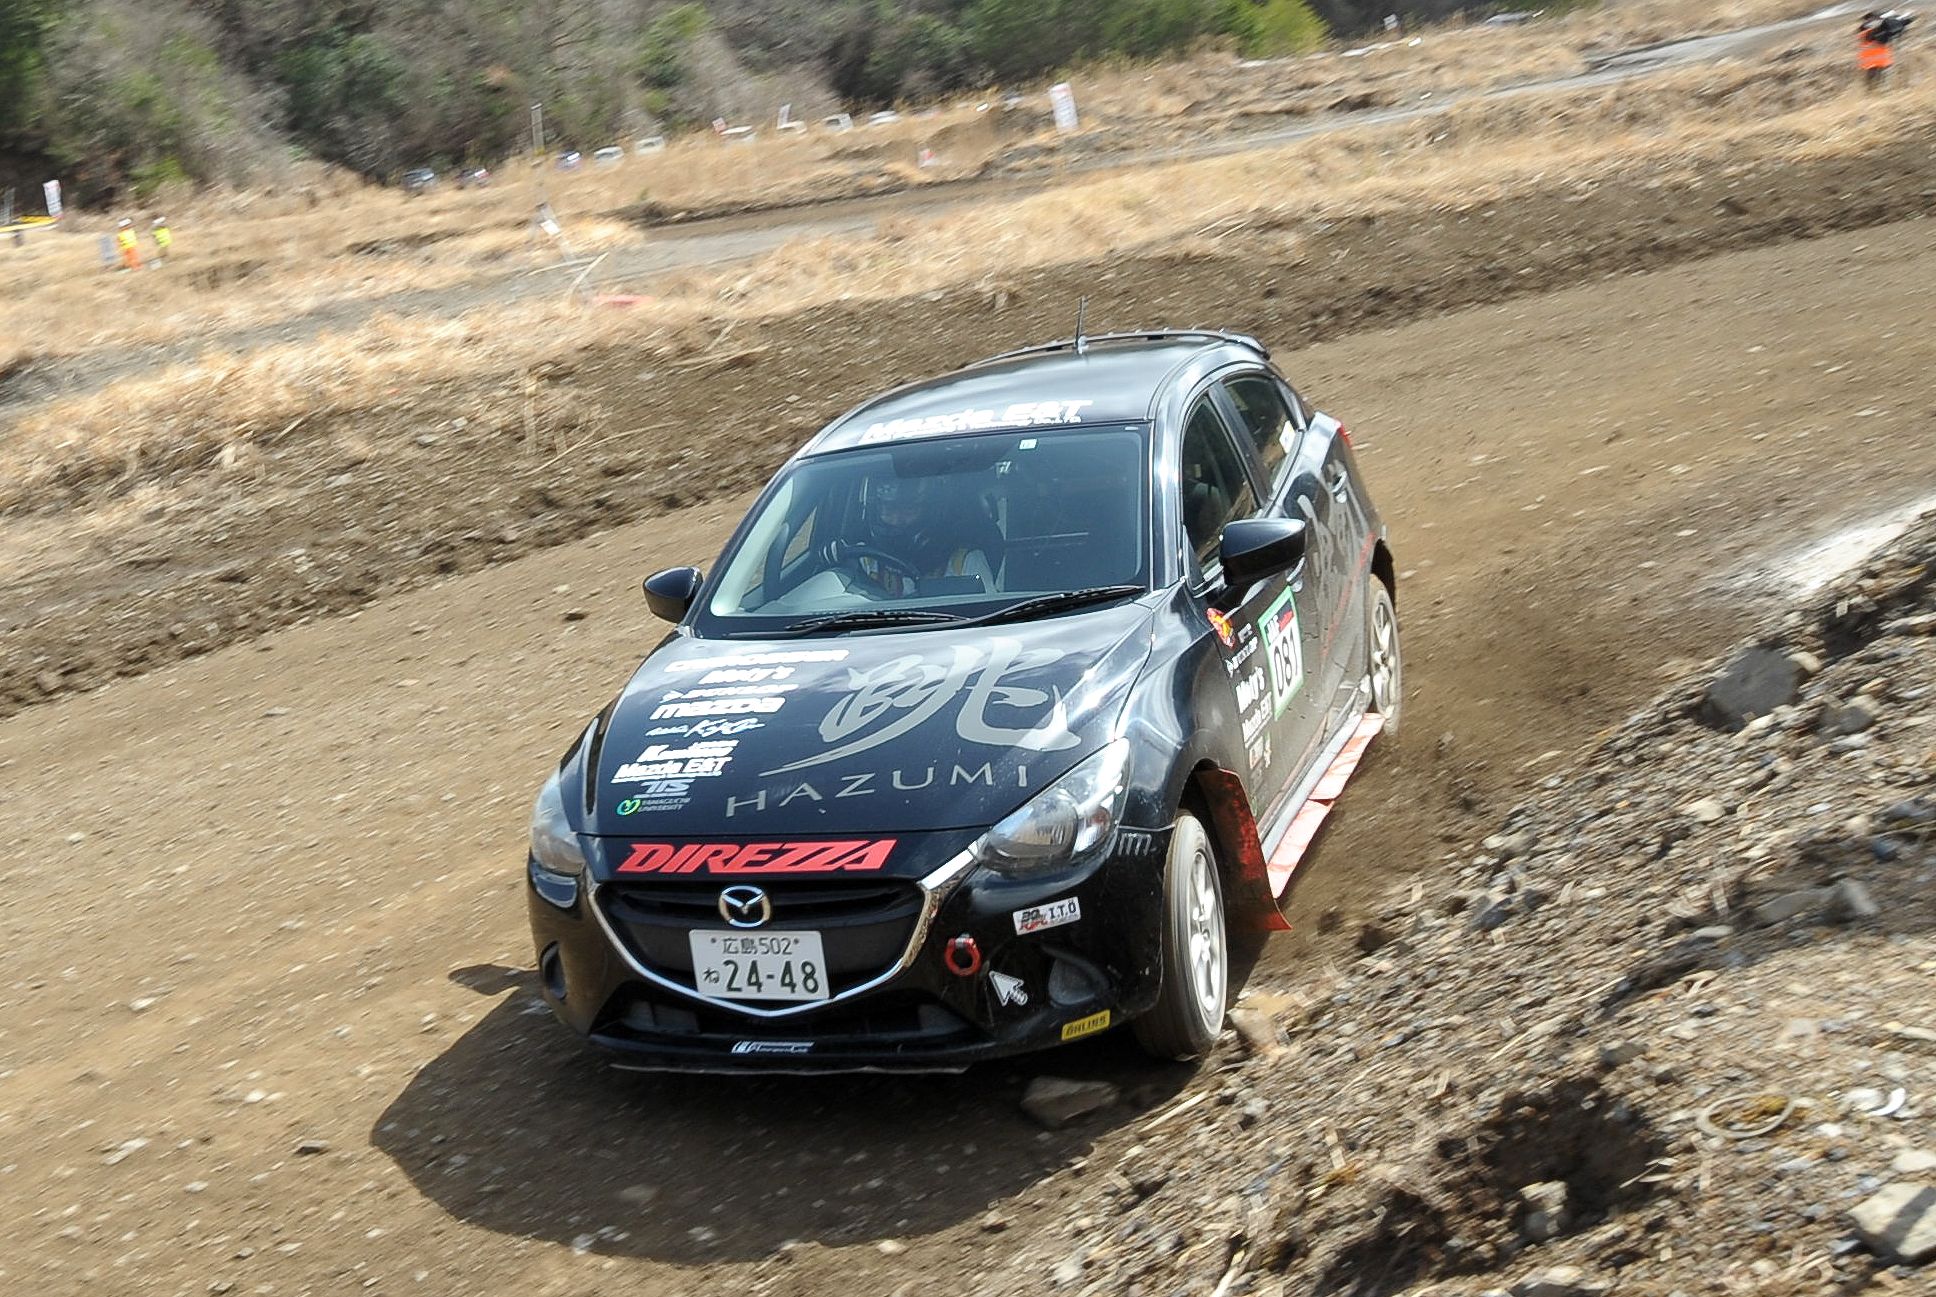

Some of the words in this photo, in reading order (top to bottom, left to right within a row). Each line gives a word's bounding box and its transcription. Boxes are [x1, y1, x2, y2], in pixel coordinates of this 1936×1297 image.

[725, 765, 1029, 818] HAZUMI
[616, 839, 898, 874] DIREZZA
[721, 959, 820, 994] 24-48
